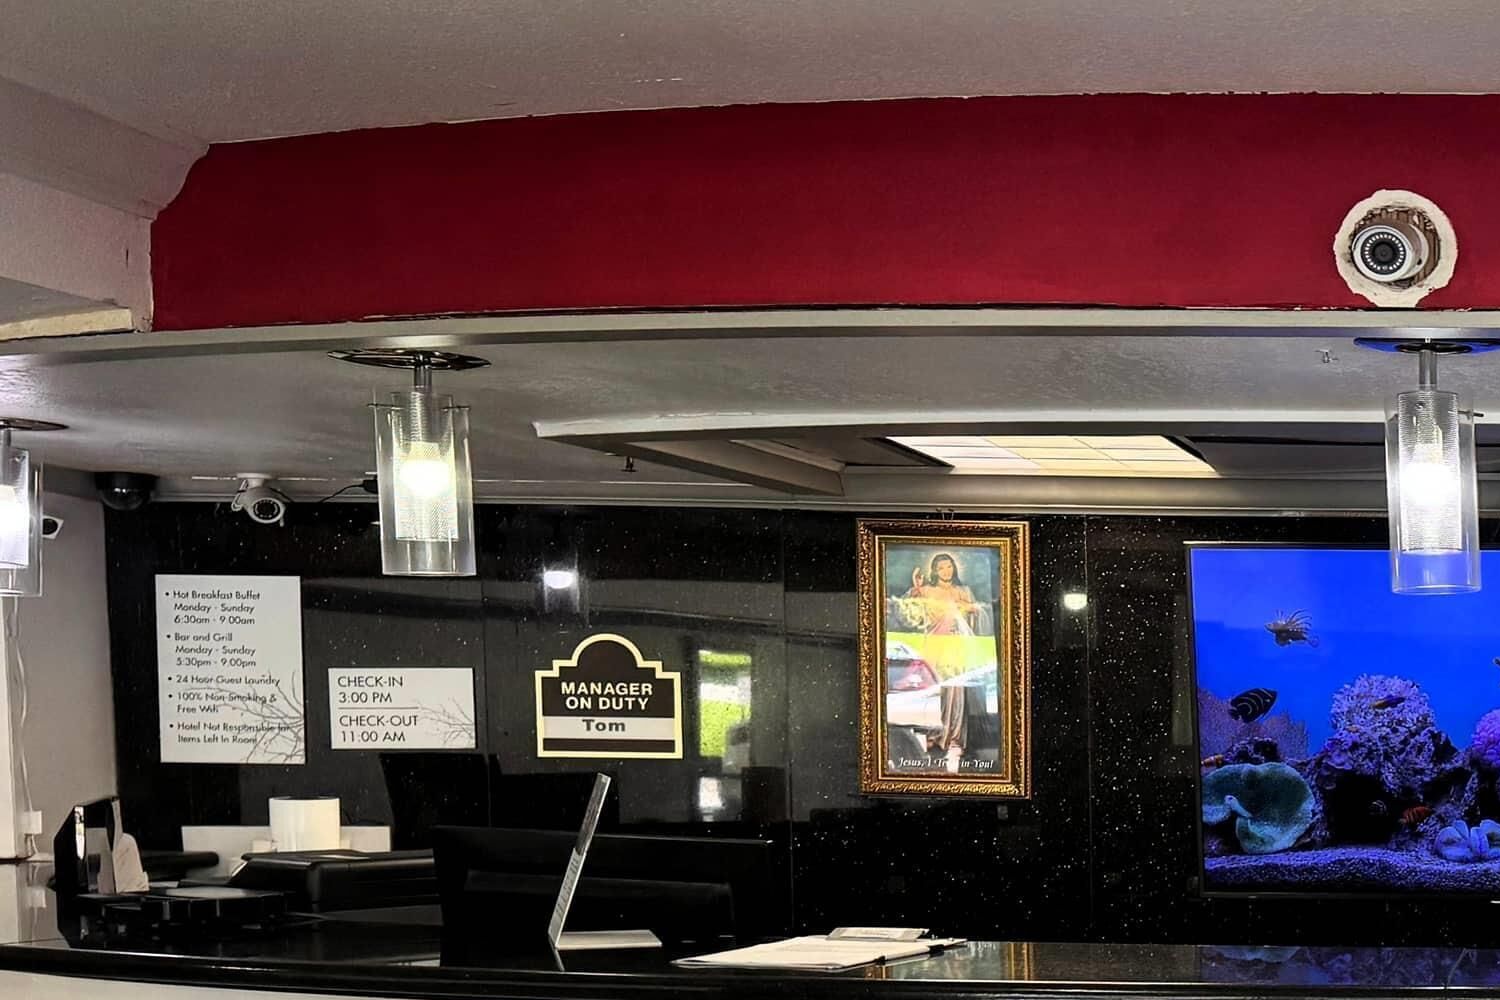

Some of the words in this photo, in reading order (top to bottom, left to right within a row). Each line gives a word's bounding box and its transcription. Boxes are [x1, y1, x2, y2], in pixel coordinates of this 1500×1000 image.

[173, 591, 188, 599] Hot
[192, 591, 232, 599] Breakfast
[236, 591, 260, 600] Buffet
[174, 603, 211, 613] Monday
[221, 603, 254, 613] Sunday
[174, 615, 210, 624] 6:30am
[193, 633, 210, 641] and
[213, 633, 232, 641] Grill
[176, 645, 213, 656] Monday
[222, 645, 256, 656] Sunday
[176, 675, 188, 683] 24
[192, 676, 213, 684] Hour
[216, 676, 242, 684] Guest
[338, 676, 403, 687] CHECK-IN
[561, 682, 652, 695] MANAGER
[178, 692, 202, 701] 100%
[269, 694, 276, 702] &
[338, 692, 368, 703] 3:00
[373, 692, 392, 703] PM
[566, 697, 591, 709] ON
[599, 698, 648, 710] DUTY
[177, 705, 196, 713] Free
[339, 715, 418, 726] CHECK-OUT
[582, 719, 625, 731] Tom
[177, 722, 200, 730] Hotel
[204, 735, 218, 743] Left
[342, 731, 378, 742] 11:00
[382, 732, 405, 742] AM
